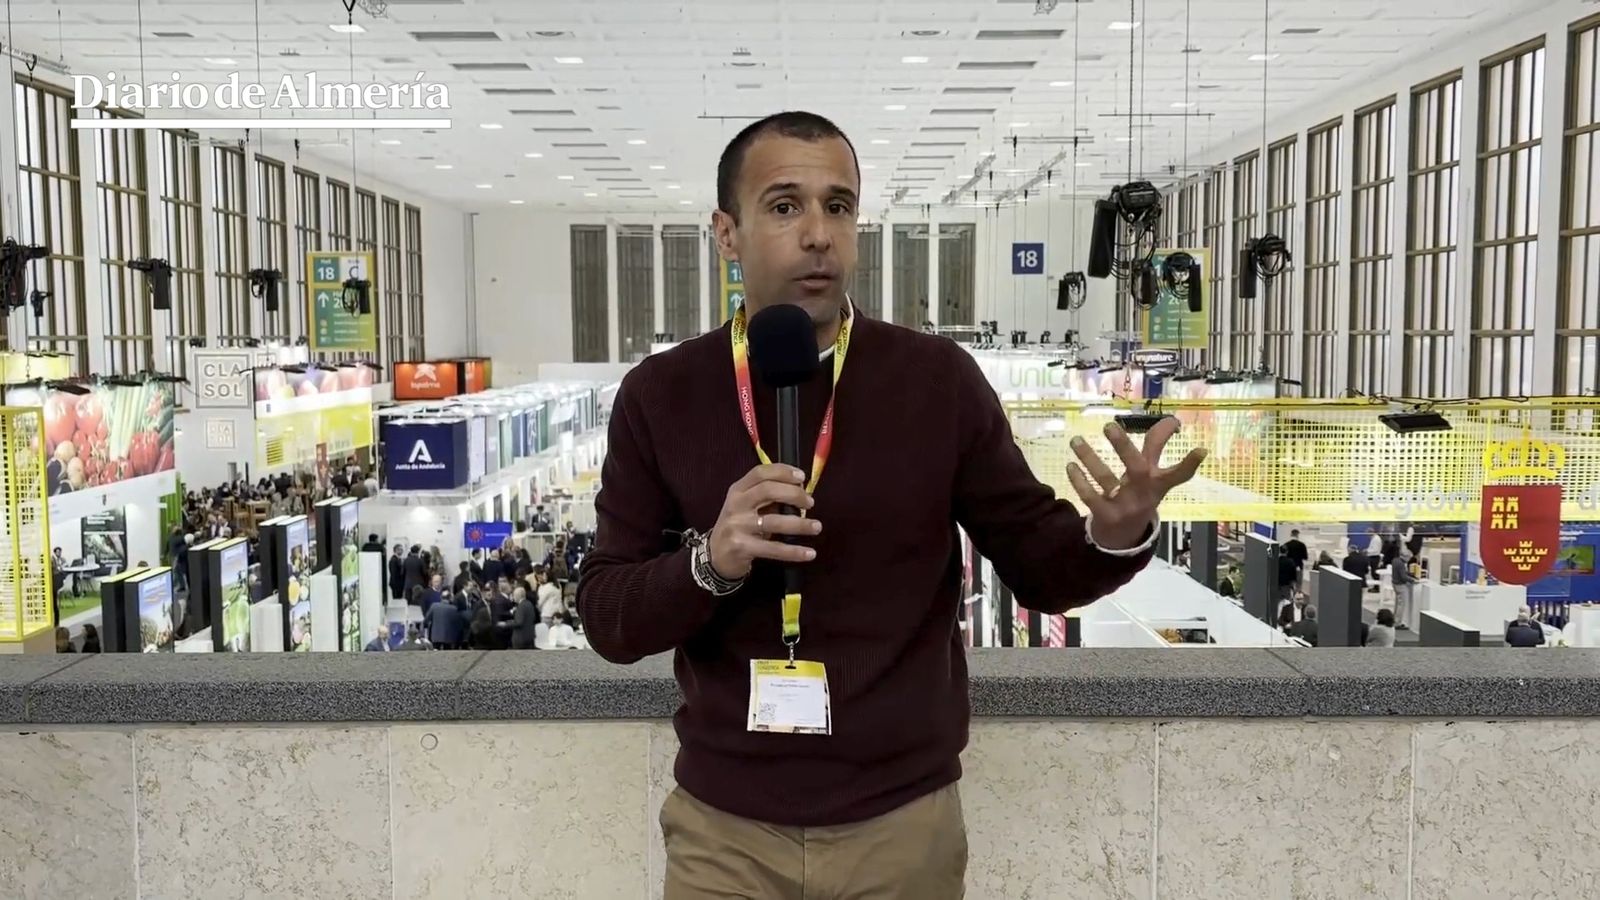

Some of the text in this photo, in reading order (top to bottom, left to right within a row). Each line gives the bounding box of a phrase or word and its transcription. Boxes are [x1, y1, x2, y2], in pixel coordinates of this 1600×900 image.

[1017, 250, 1038, 268] 18
[318, 267, 335, 281] 18
[204, 363, 241, 377] CLA
[204, 384, 243, 397] SOL
[741, 386, 754, 436] HONG KONG
